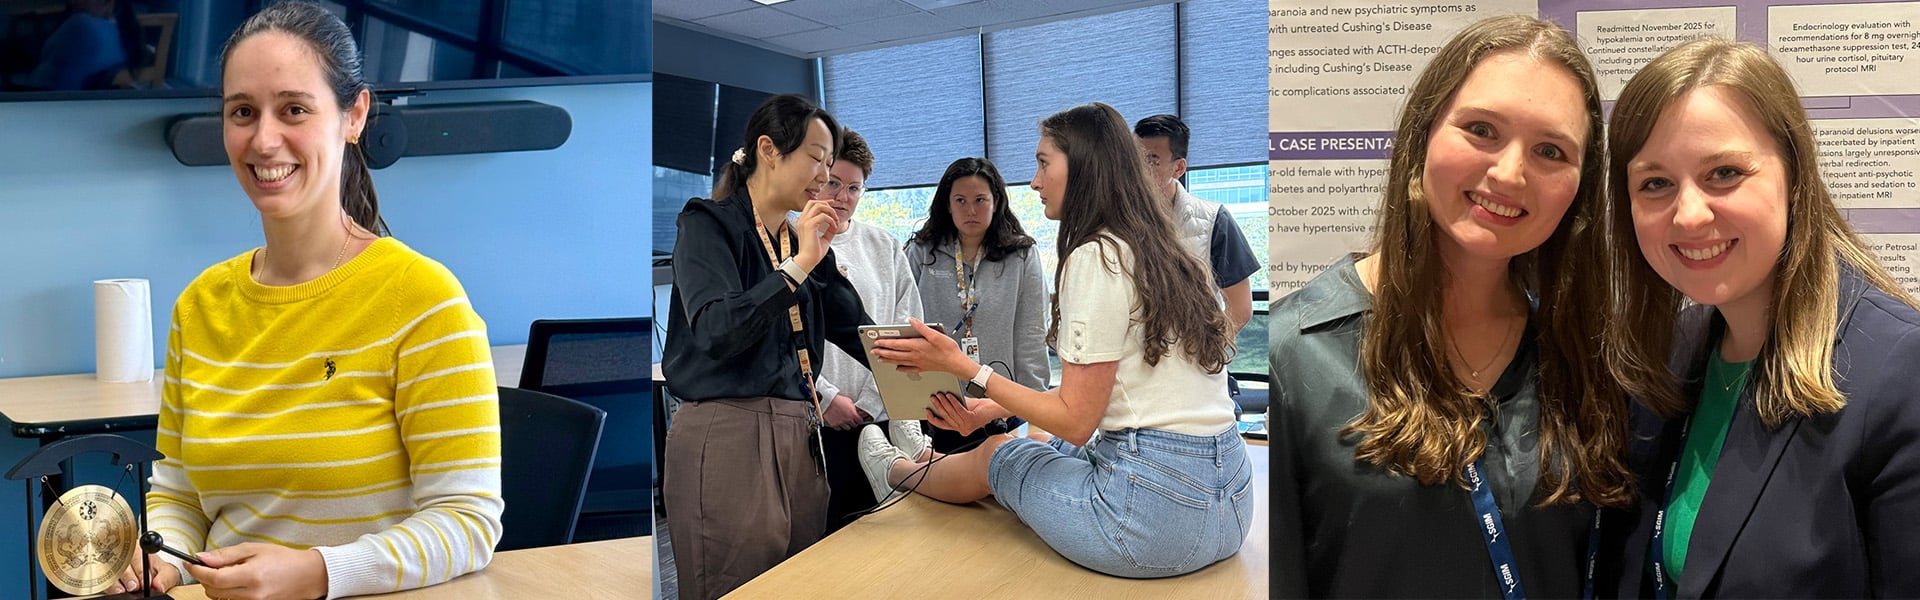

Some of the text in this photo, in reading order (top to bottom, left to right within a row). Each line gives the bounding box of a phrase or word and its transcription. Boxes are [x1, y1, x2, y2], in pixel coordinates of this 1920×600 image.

[1355, 5, 1407, 16] psychiatric
[1410, 5, 1462, 14] symptoms
[1291, 24, 1338, 33] untreated
[1342, 22, 1390, 33] Cushing's
[1394, 22, 1432, 31] Disease
[1597, 24, 1640, 33] Readmitted
[1793, 23, 1848, 31] Endocrinology
[1851, 21, 1891, 29] evaluation
[1657, 33, 1695, 42] outpatient
[1299, 46, 1349, 56] associated
[1353, 46, 1373, 55] with
[1843, 43, 1889, 52] suppression
[1599, 56, 1631, 65] including
[1838, 54, 1869, 62] cortisol,
[1871, 54, 1904, 62] pituitary
[1275, 64, 1319, 75] including
[1374, 62, 1412, 71] Disease
[1825, 66, 1858, 74] protocol
[1282, 87, 1349, 97] complications
[1353, 86, 1405, 95] associated
[1820, 128, 1854, 136] paranoid
[1280, 139, 1316, 150] CASE
[1880, 138, 1915, 146] inpatient
[1845, 149, 1871, 158] largely
[1299, 167, 1331, 176] female
[1335, 167, 1355, 176] with
[1859, 170, 1913, 178] anti-psychotic
[1307, 184, 1325, 193] and
[1839, 192, 1874, 200] inpatient
[1311, 207, 1335, 216] 2025
[1338, 207, 1359, 215] with
[1278, 223, 1300, 232] have
[1303, 224, 1365, 234] hypertensive
[1286, 261, 1298, 273] by
[1483, 513, 1496, 535] SGIM
[1656, 510, 1664, 530] SGIM
[1500, 564, 1514, 585] SGIM
